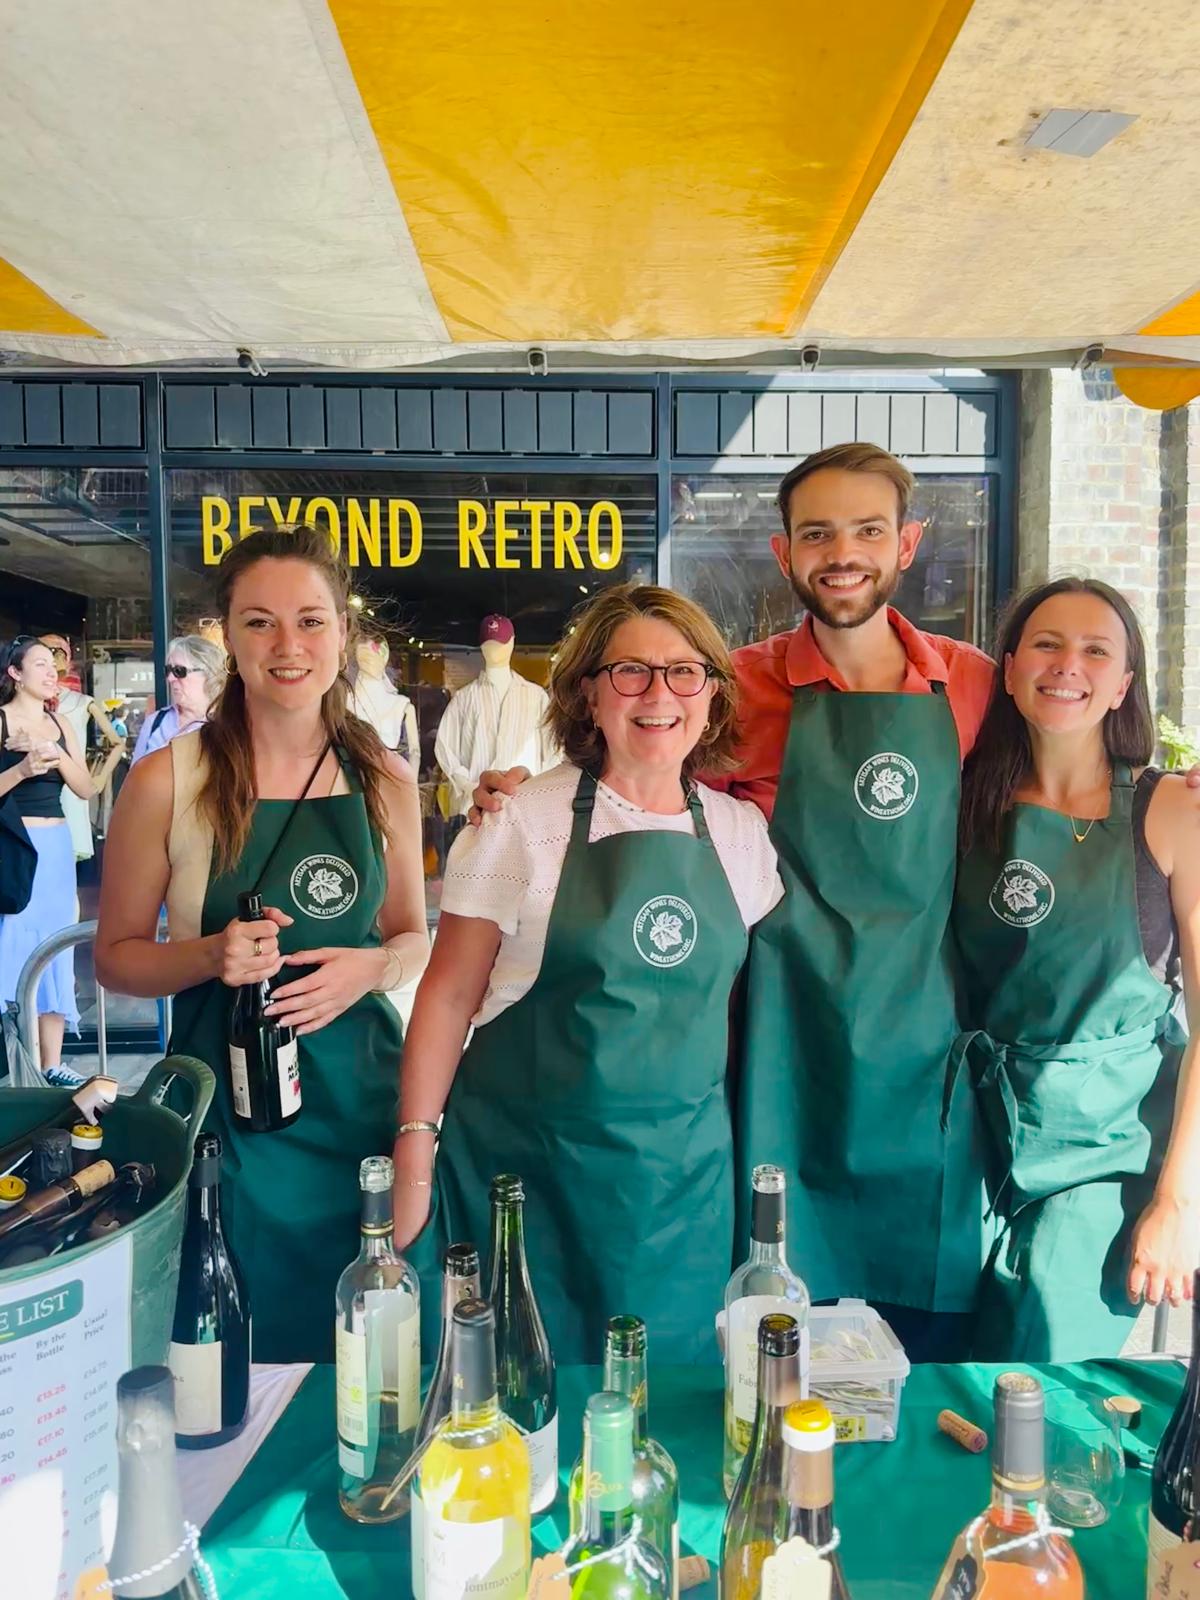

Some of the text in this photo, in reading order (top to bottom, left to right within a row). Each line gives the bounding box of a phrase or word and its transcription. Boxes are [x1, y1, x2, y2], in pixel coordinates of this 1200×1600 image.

[201, 496, 623, 570] BEYOND RETRO
[872, 756, 889, 766] WINES
[890, 756, 914, 777] DELIVERED
[306, 857, 325, 867] WINES
[325, 858, 351, 877] DELIVERED
[1021, 864, 1048, 886] DELIVERED
[649, 899, 668, 910] WINES
[668, 899, 692, 921] DELIVERED
[16, 1290, 69, 1327] LIST
[84, 1308, 109, 1328] Usual
[36, 1332, 66, 1350] By the
[84, 1325, 105, 1341] Price
[36, 1345, 65, 1361] Bottle
